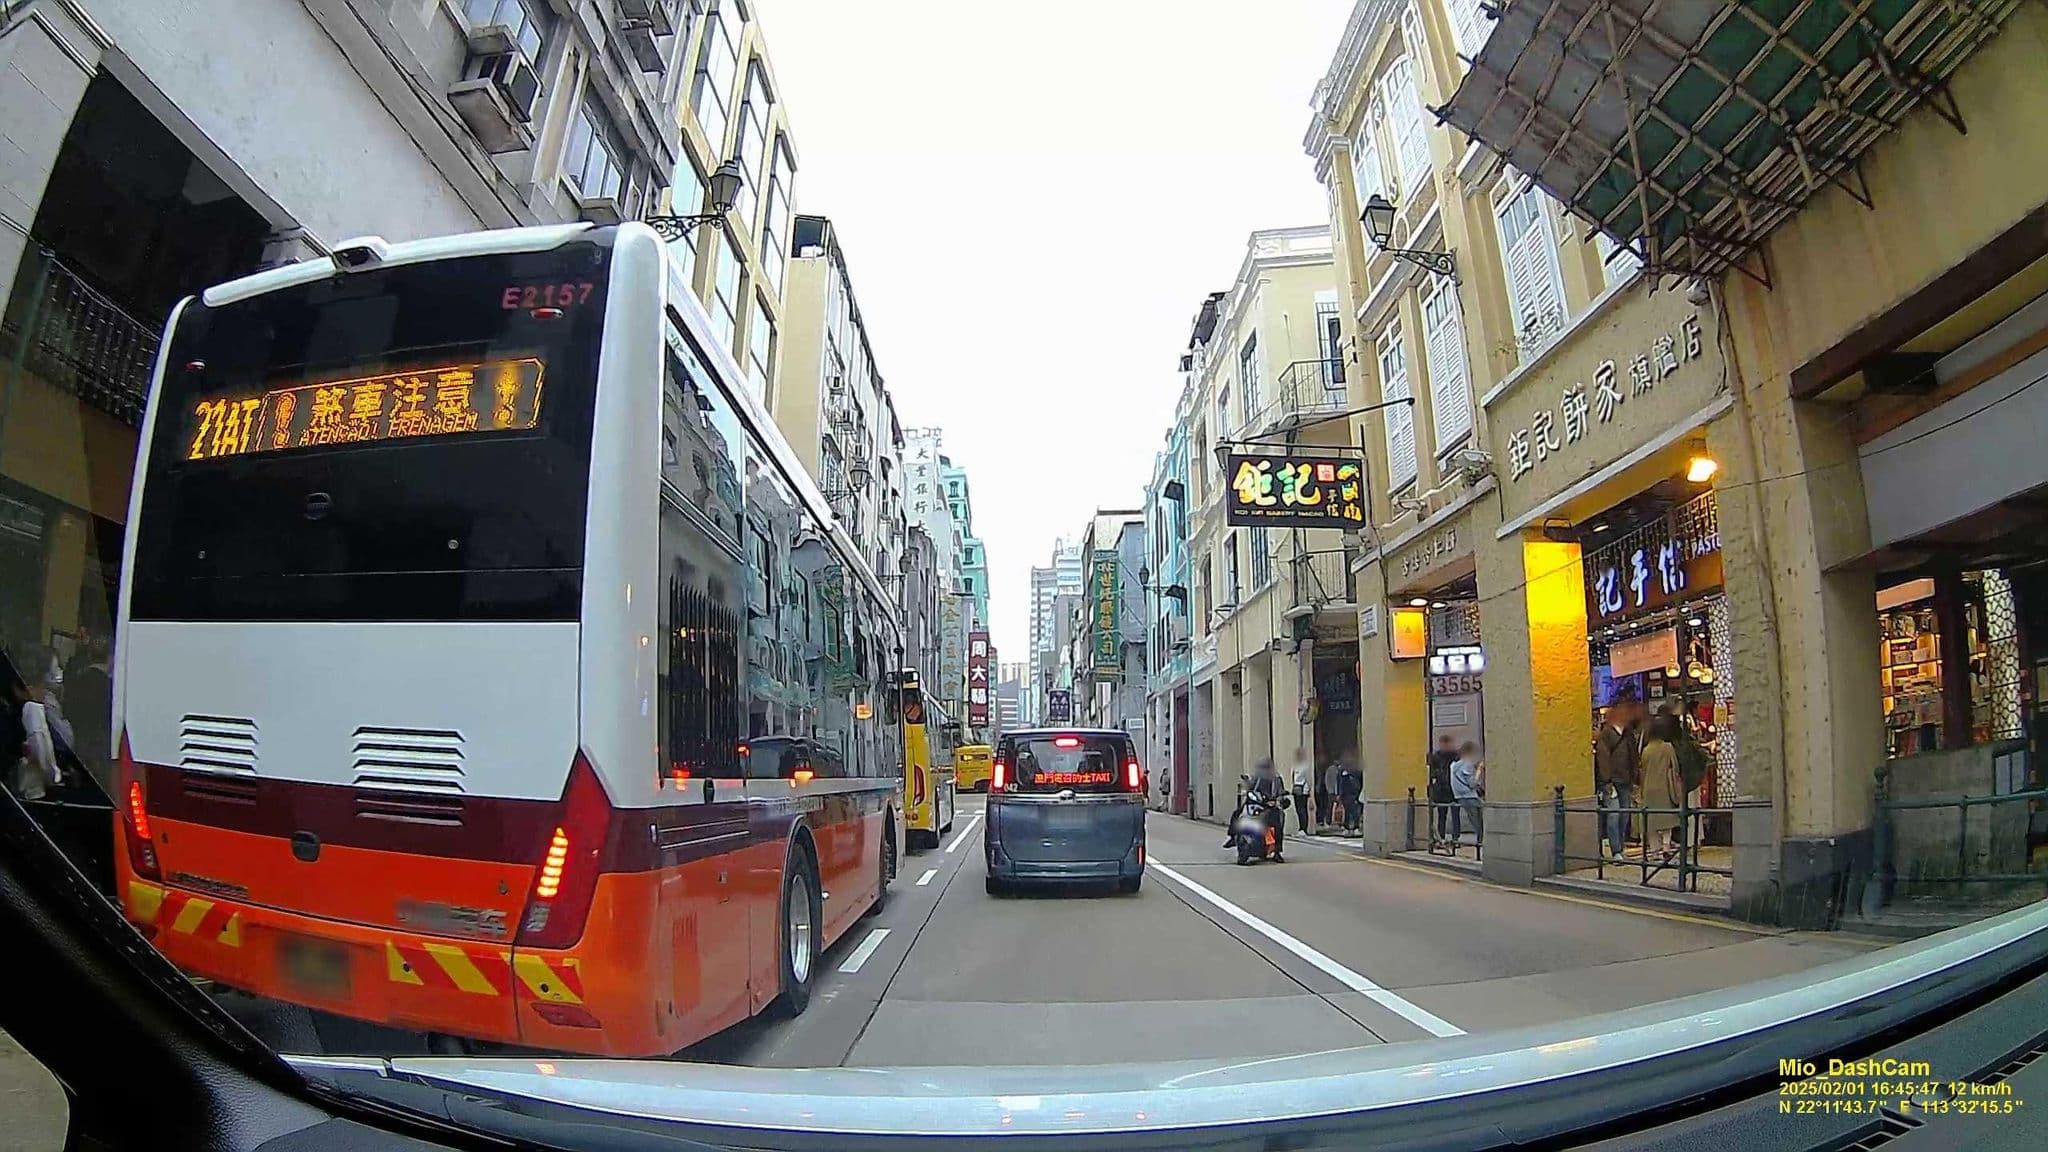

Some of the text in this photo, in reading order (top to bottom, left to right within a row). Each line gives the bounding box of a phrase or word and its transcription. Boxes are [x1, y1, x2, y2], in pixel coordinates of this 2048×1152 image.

[502, 283, 593, 309] E2157
[311, 371, 474, 425] 煞車注意
[1508, 314, 1702, 482] 鉅記餅家 旗艦店
[388, 413, 478, 437] FRENAGEM
[1232, 460, 1321, 507] 鉅記
[971, 641, 987, 704] 周大福
